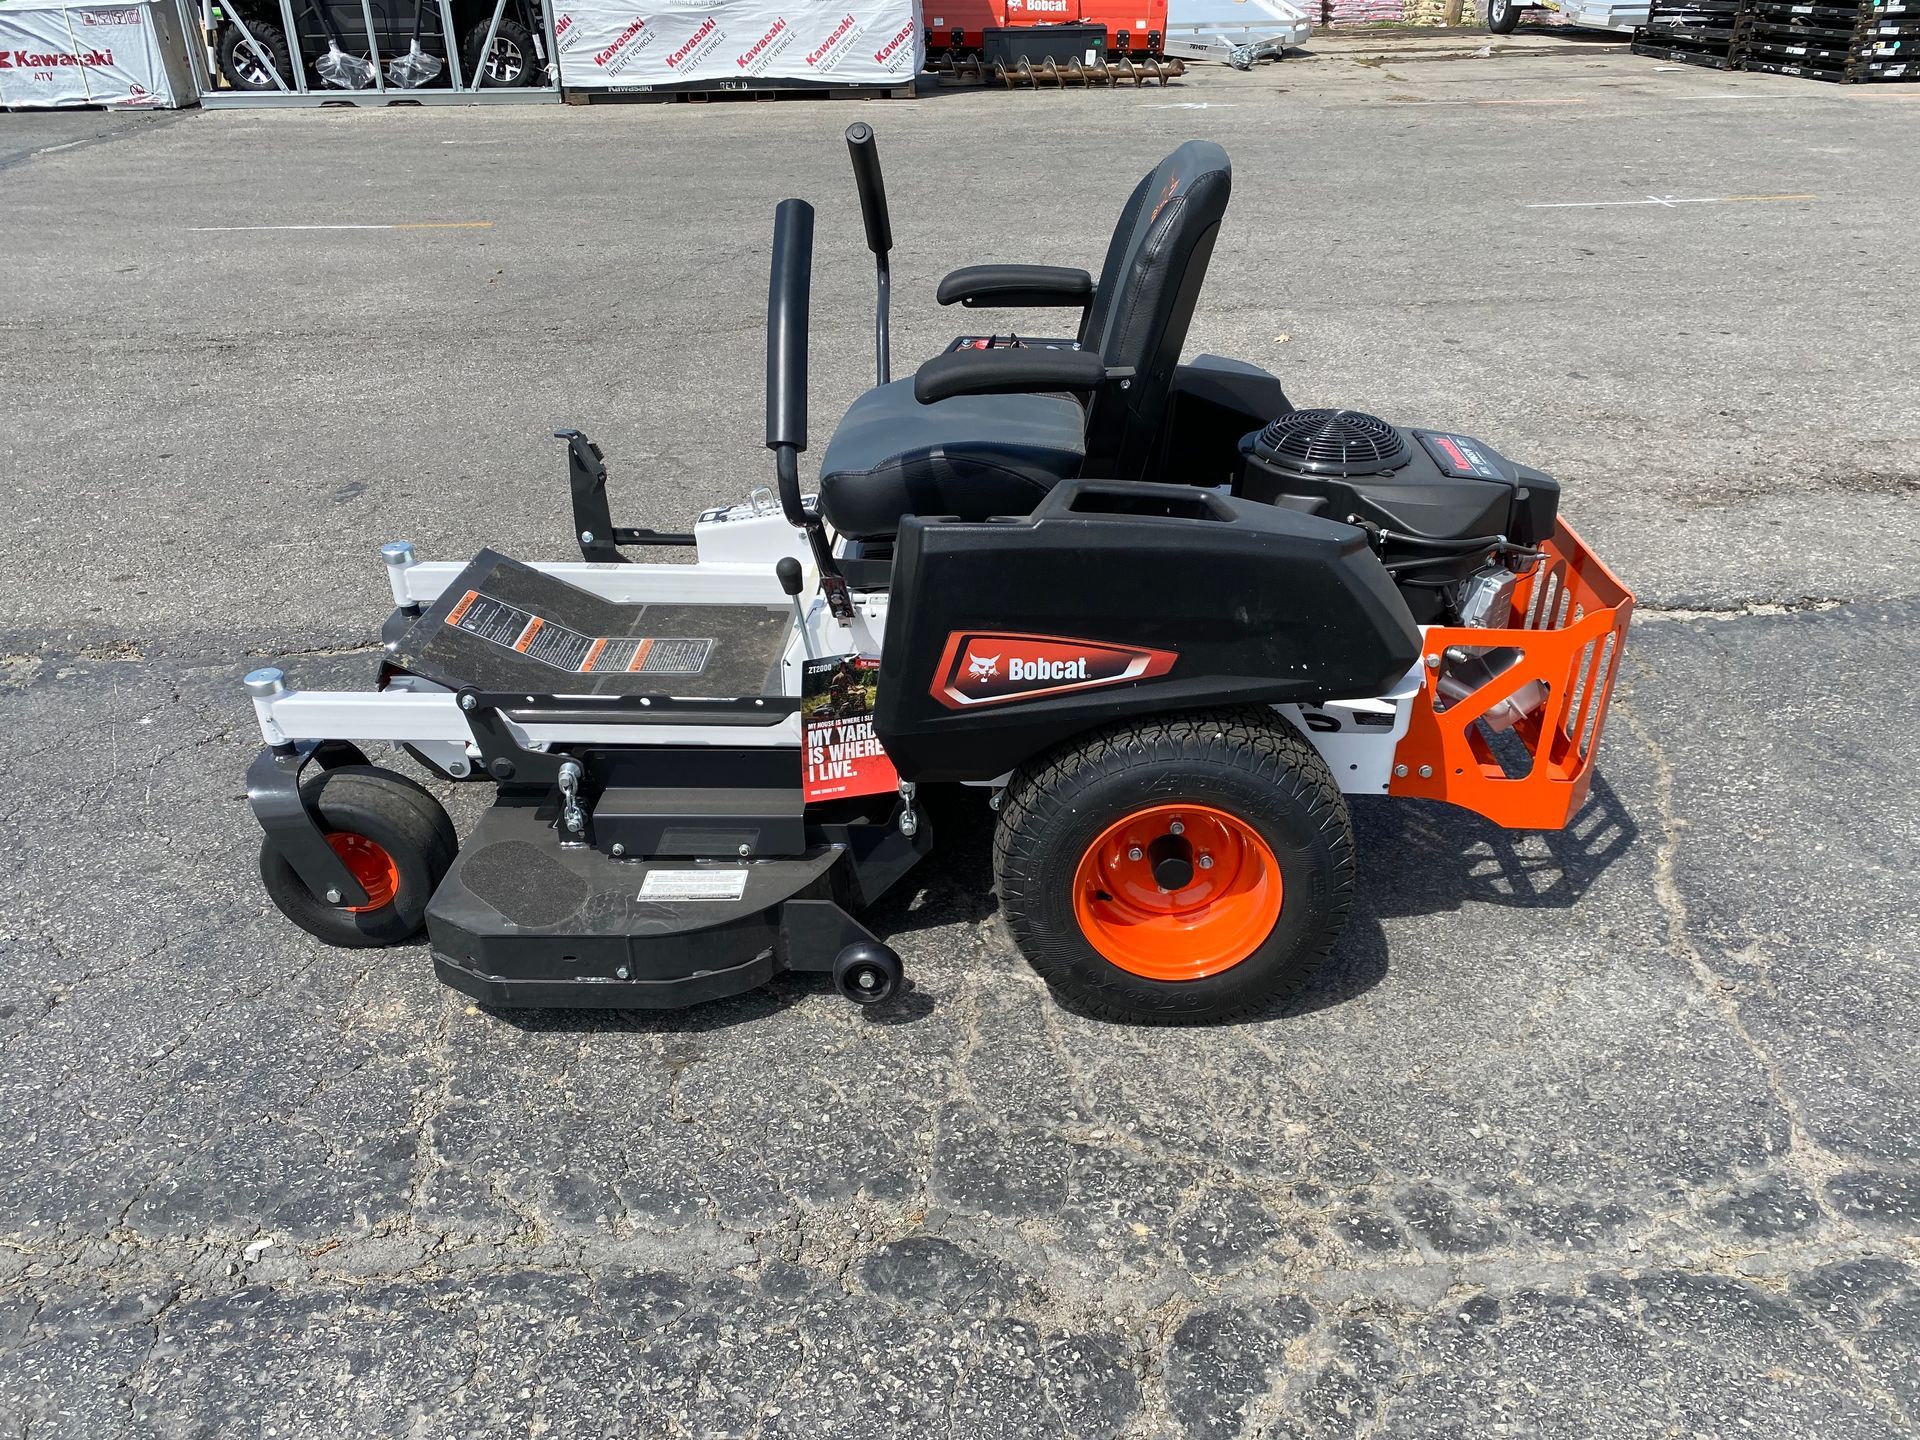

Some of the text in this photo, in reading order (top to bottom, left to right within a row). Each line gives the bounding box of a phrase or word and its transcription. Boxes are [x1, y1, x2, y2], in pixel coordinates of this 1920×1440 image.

[1026, 0, 1067, 12] Bobcat
[593, 16, 645, 68] Kawasaki
[665, 16, 717, 69] Kawasaki
[701, 31, 728, 58] VEHICLE
[735, 16, 788, 69] Kawasaki
[771, 31, 798, 58] VEHICLE
[804, 13, 857, 66] Kawasaki
[839, 27, 866, 54] VEHICLE
[873, 17, 914, 65] Kawasa
[14, 49, 114, 68] Kawasaki
[608, 31, 657, 79] UTILITY VEHICLE
[887, 50, 912, 75] UTILITY
[34, 72, 54, 82] ATV
[719, 81, 737, 90] REV
[808, 663, 832, 675] ZT2000
[1009, 656, 1088, 681] Bobcat
[817, 720, 835, 729] HOUSE
[842, 716, 860, 725] WHERE
[807, 728, 833, 749] MY
[808, 738, 886, 766] IS WHERE
[808, 760, 858, 783] I LIVE.
